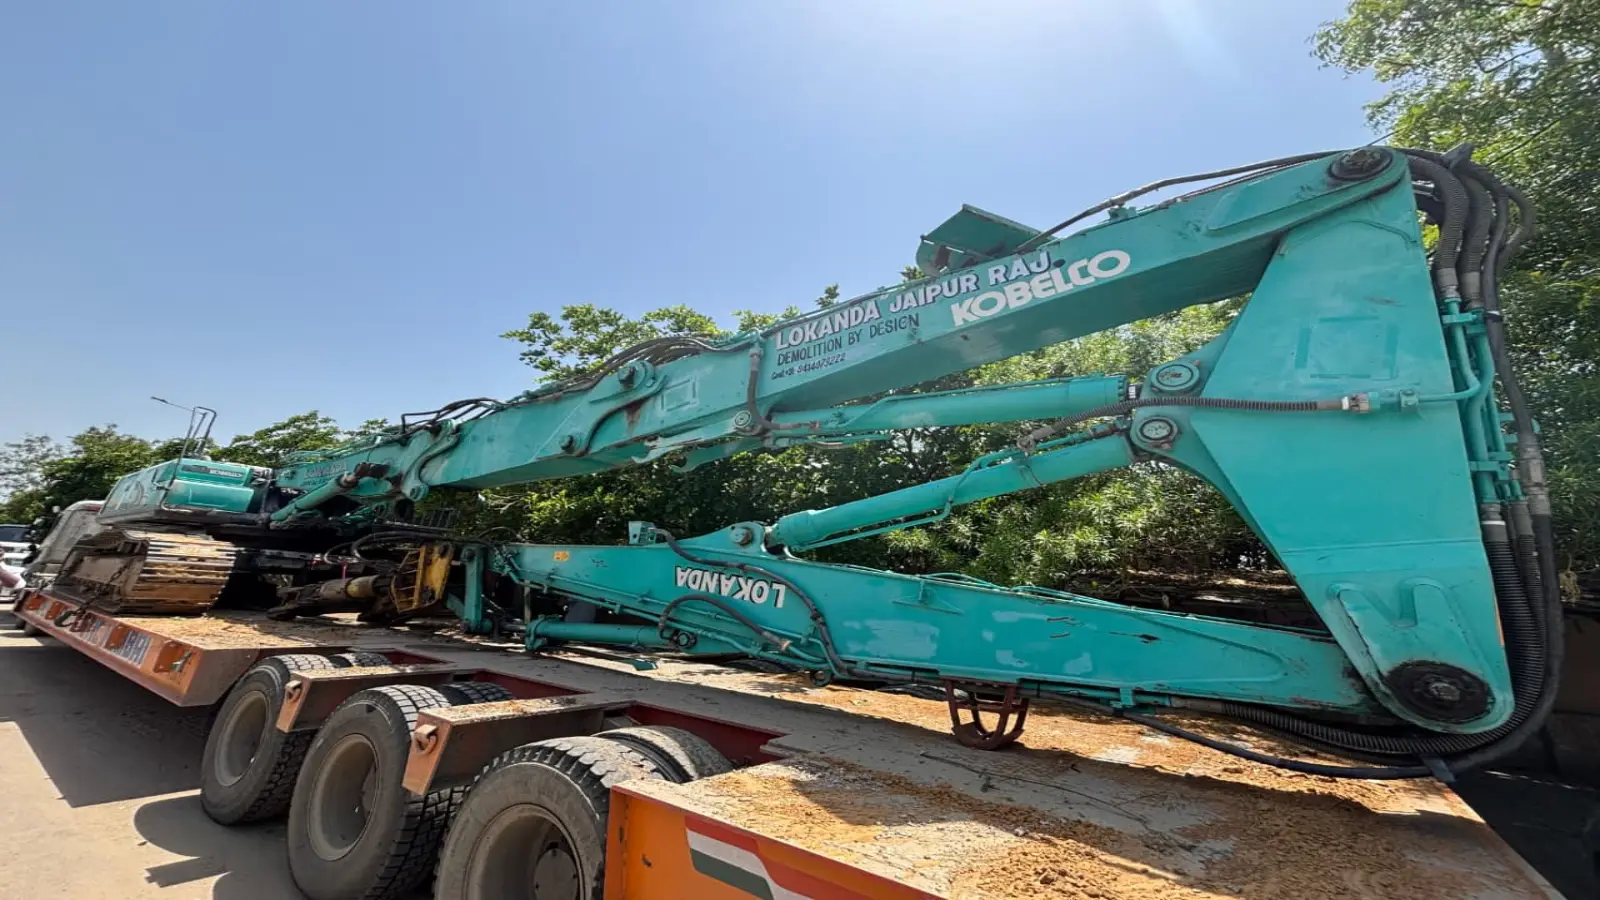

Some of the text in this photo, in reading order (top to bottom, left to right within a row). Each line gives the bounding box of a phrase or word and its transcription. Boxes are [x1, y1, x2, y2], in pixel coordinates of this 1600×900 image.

[775, 299, 881, 350] LOKANDA
[889, 272, 980, 314] JAIPUR
[951, 249, 1131, 328] KOBELCO
[777, 312, 920, 366] DEMOLITION BY DESIGN
[675, 565, 787, 608] LOKANDA
